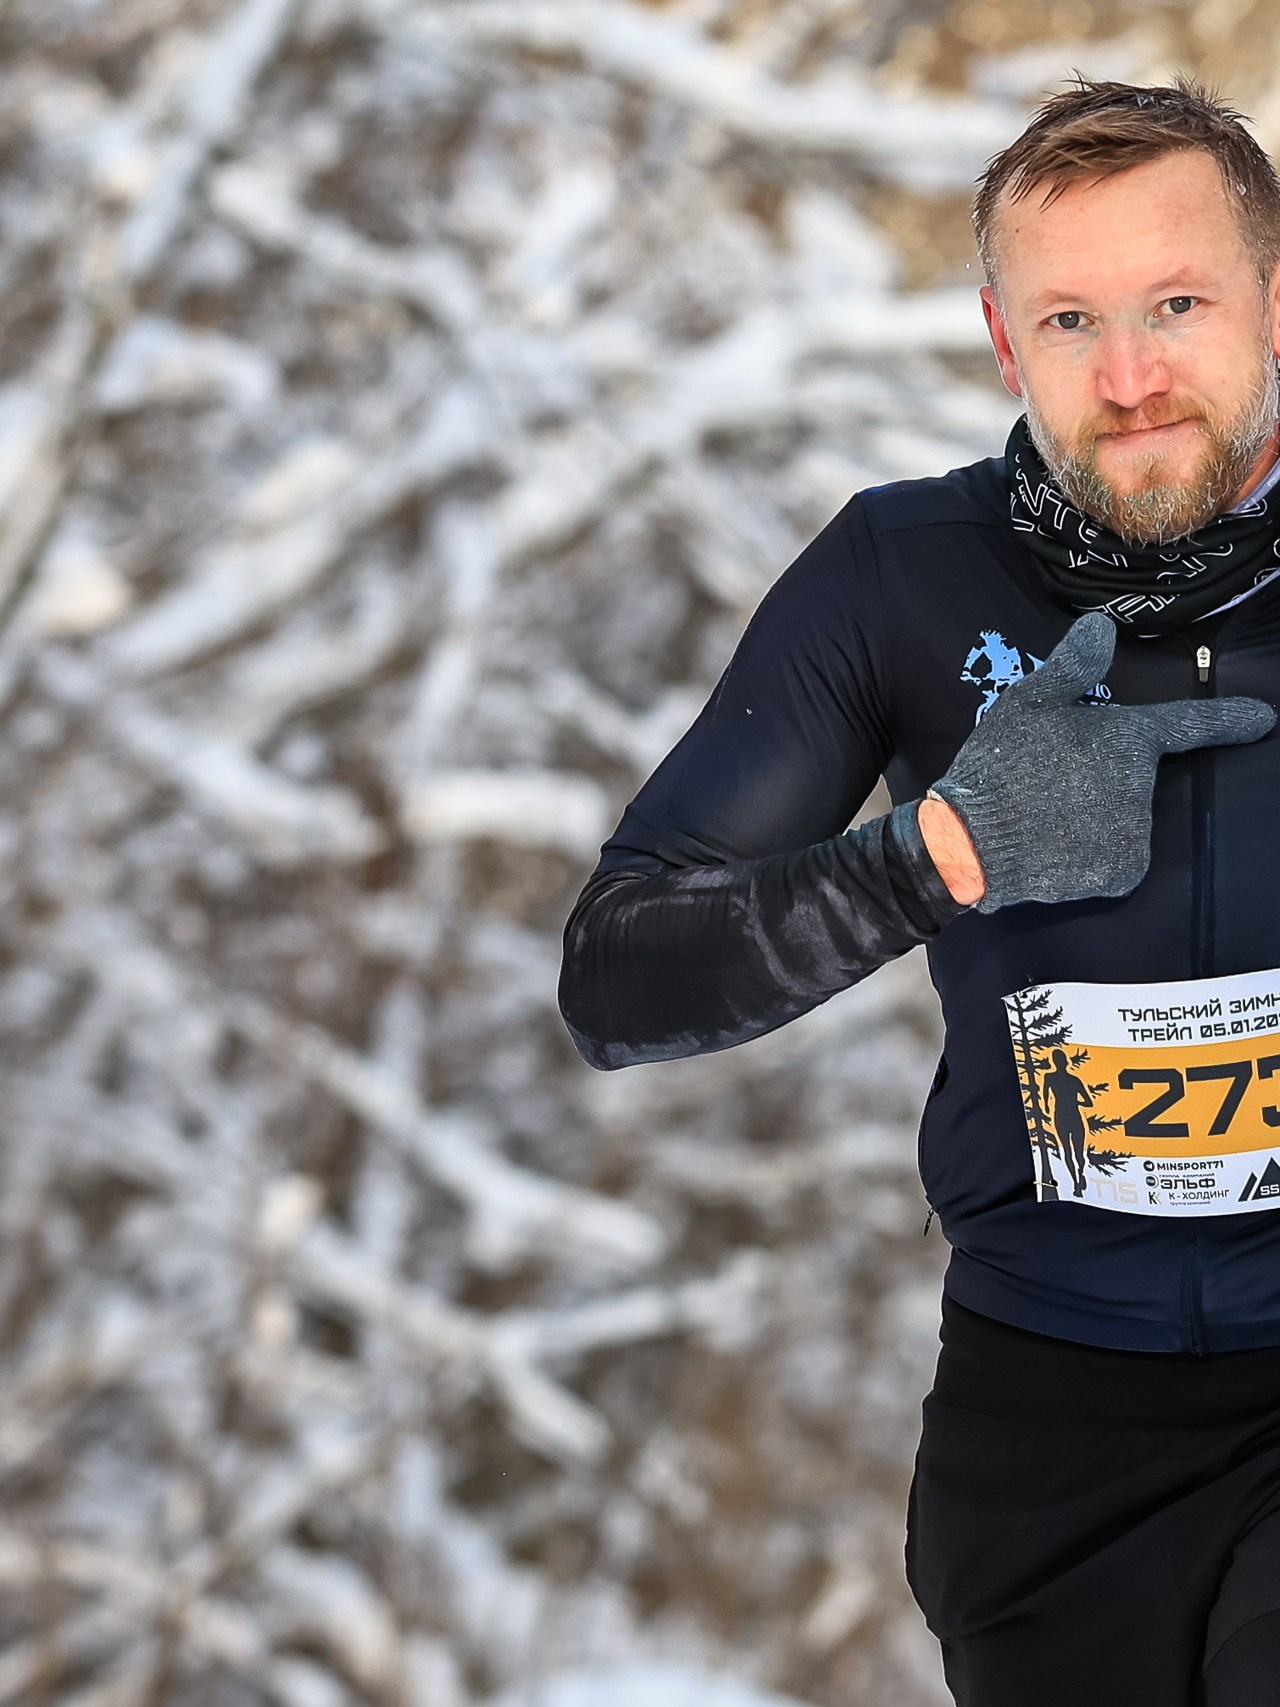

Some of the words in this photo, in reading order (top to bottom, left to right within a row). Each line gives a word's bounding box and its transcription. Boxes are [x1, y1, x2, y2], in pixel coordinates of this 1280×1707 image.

[1117, 998, 1223, 1023] ТУЛЬСКИЙ
[1128, 1023, 1193, 1043] ТРЕЙЛ
[1156, 1160, 1224, 1171] MINSPORT71
[1160, 1178, 1216, 1190] ЭЛЬФ
